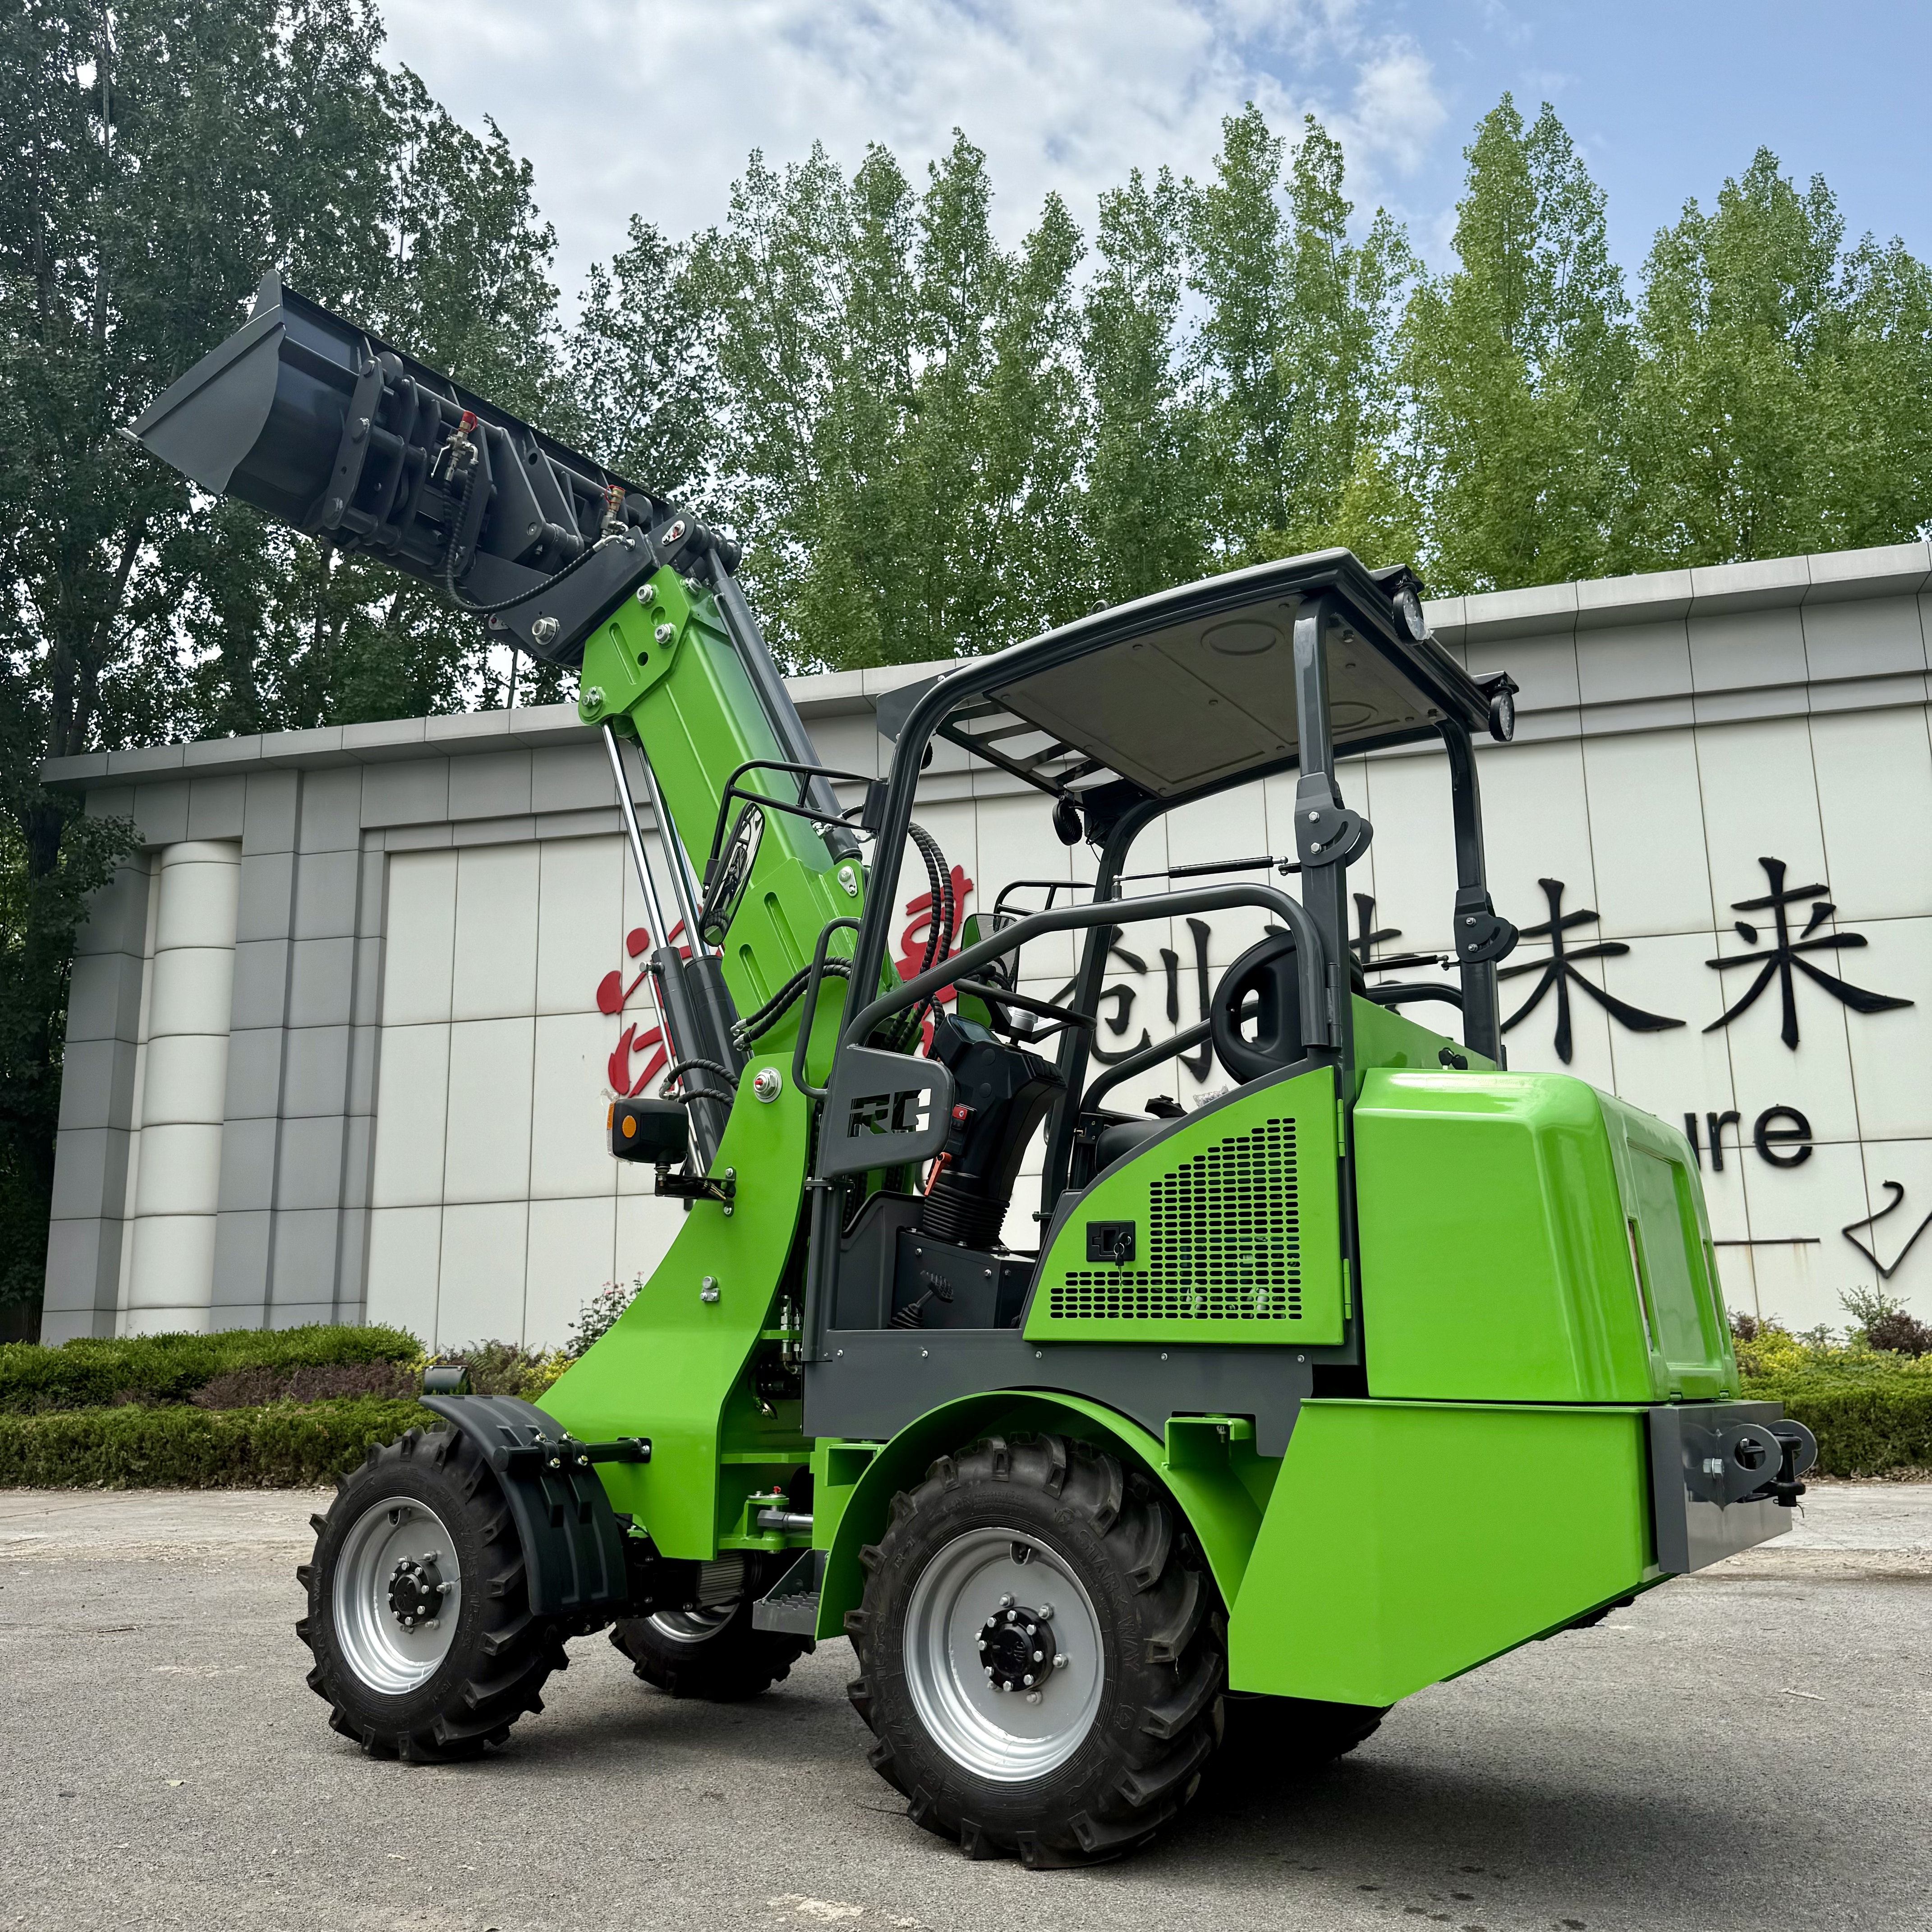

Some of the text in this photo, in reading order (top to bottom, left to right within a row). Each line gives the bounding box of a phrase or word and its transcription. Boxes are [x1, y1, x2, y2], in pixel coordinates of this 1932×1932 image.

[314, 1562, 323, 1602] WAY
[1075, 1529, 1121, 1593] STAR
[1116, 1615, 1140, 1672] WAY
